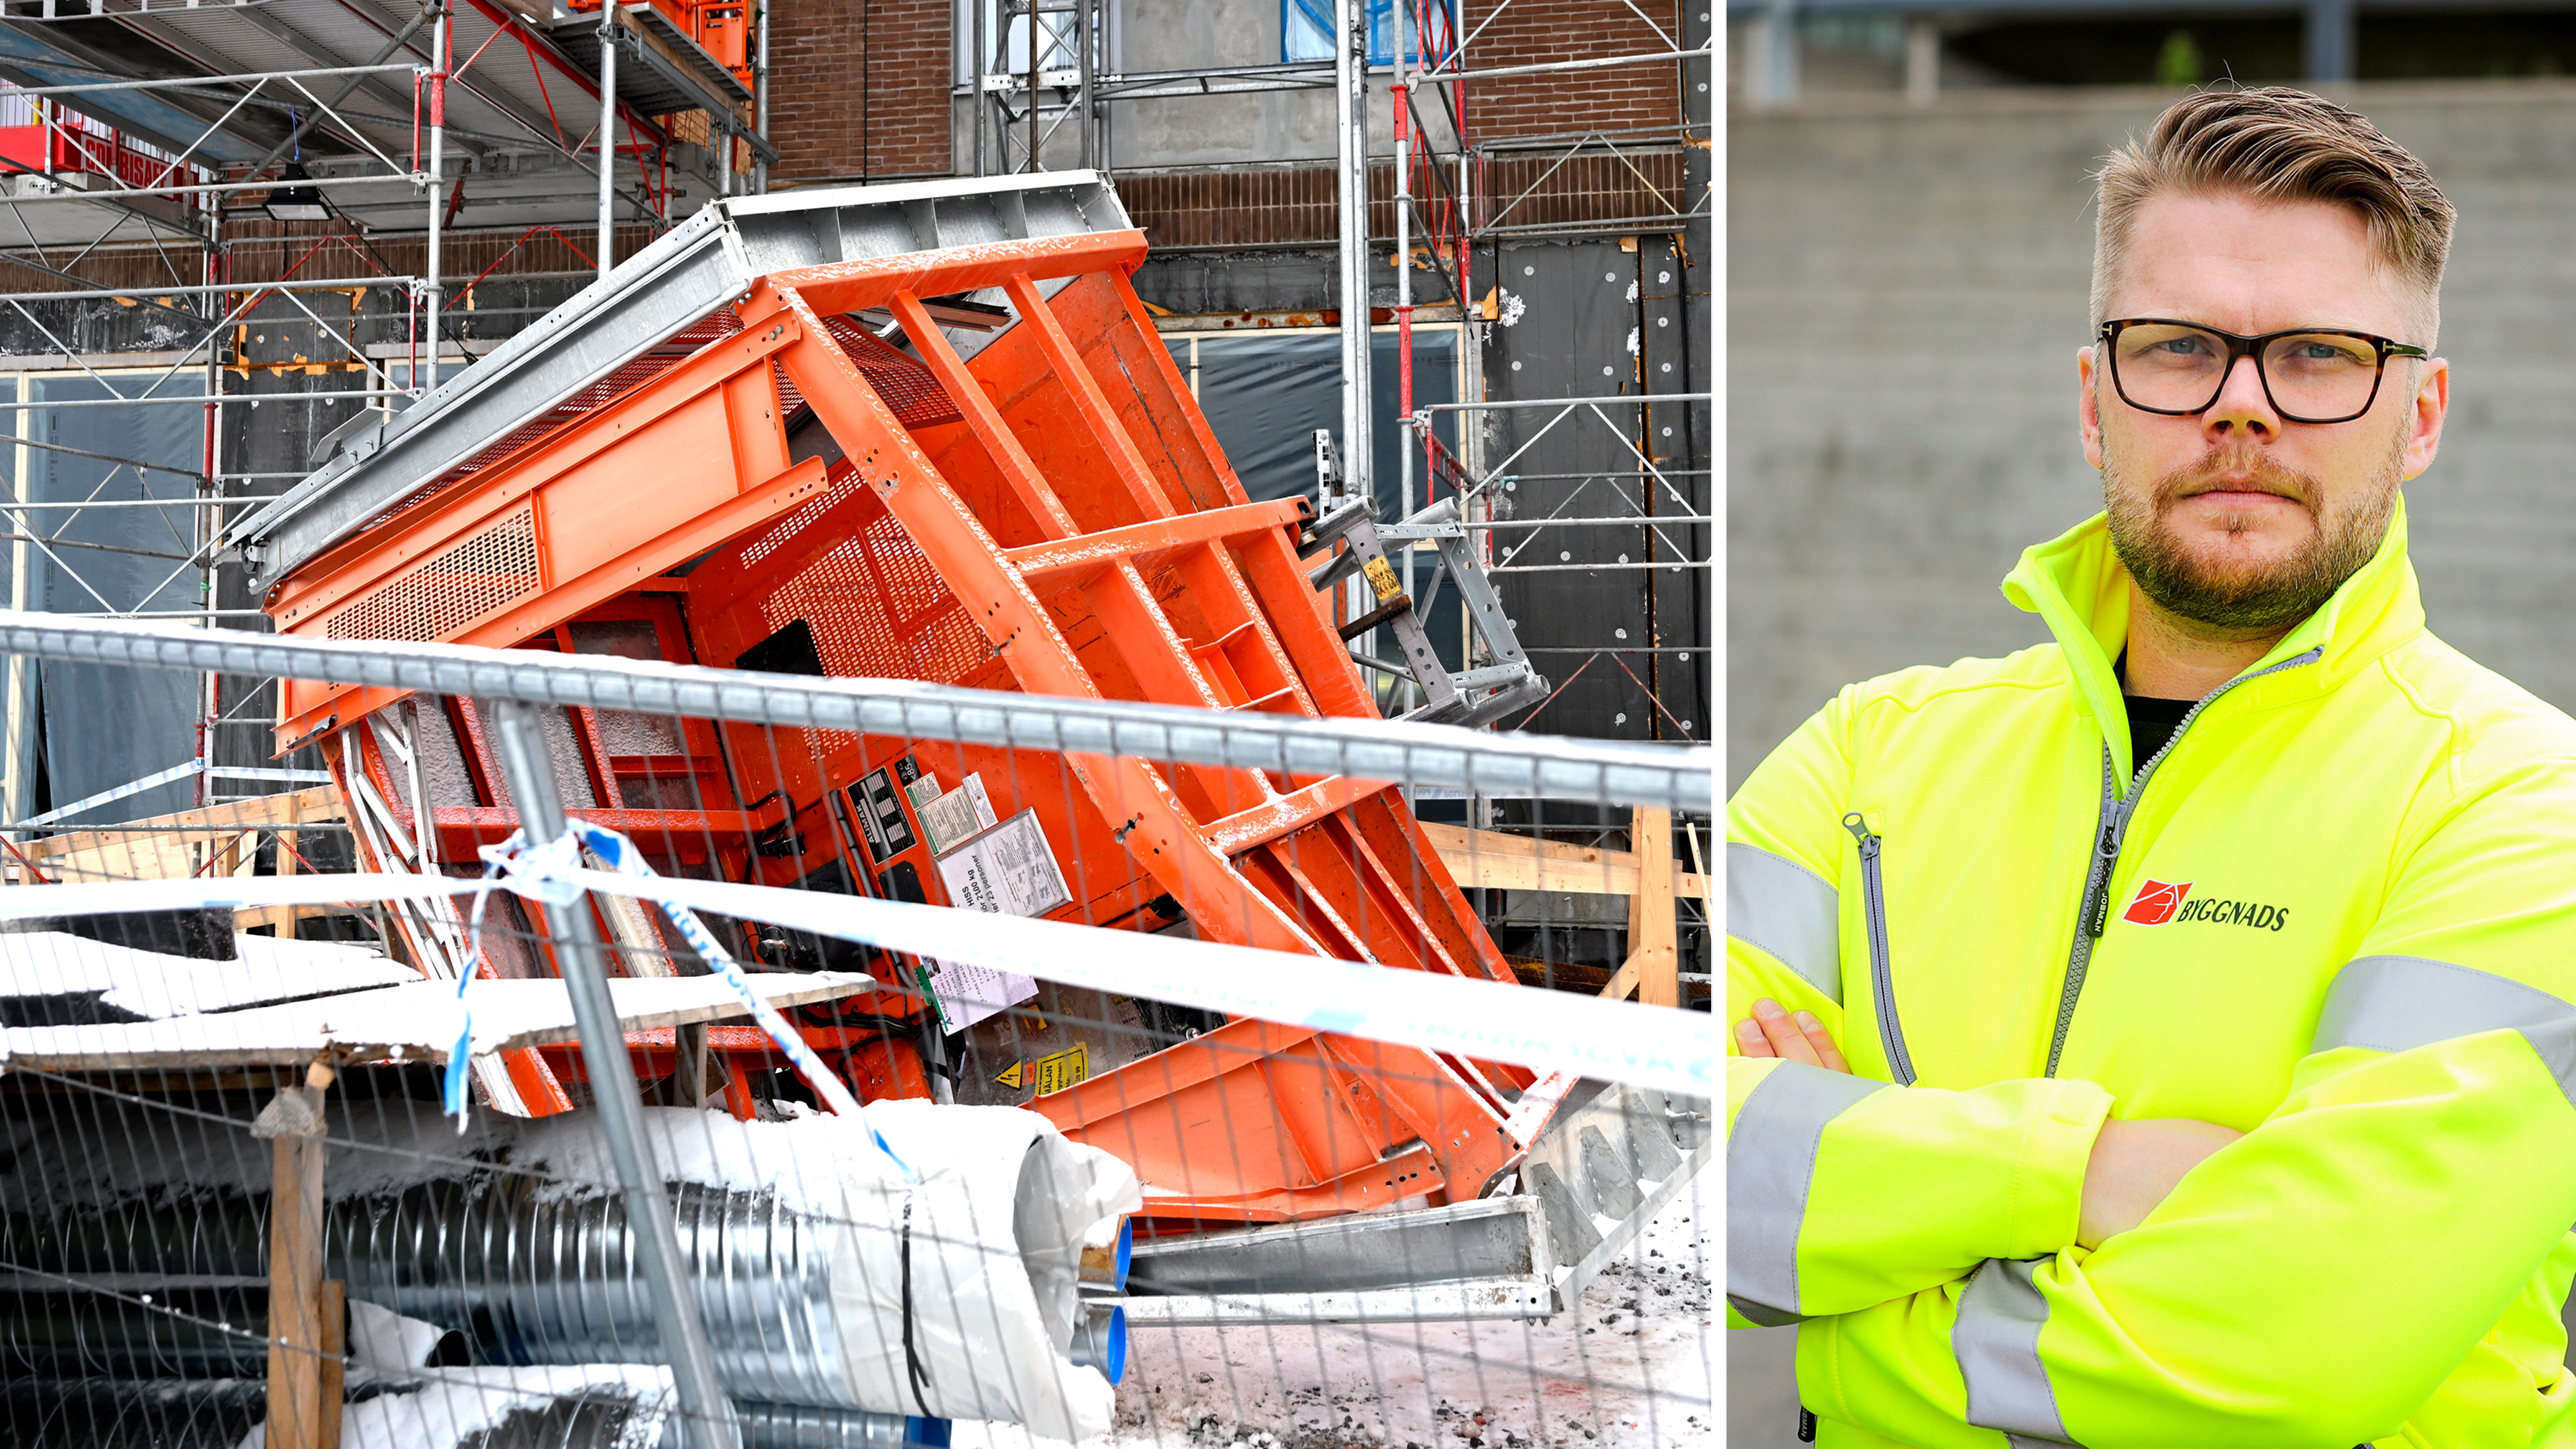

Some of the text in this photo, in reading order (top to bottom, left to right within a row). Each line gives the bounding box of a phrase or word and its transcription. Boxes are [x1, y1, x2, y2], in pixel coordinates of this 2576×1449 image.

[856, 804, 875, 843] ALIMAK
[967, 869, 976, 881] kg
[971, 855, 992, 889] personer
[962, 886, 974, 907] HISS
[971, 882, 983, 901] 2100
[985, 891, 995, 902] 23
[2094, 893, 2108, 932] JOBMAN
[2177, 898, 2289, 932] BYGGNADS
